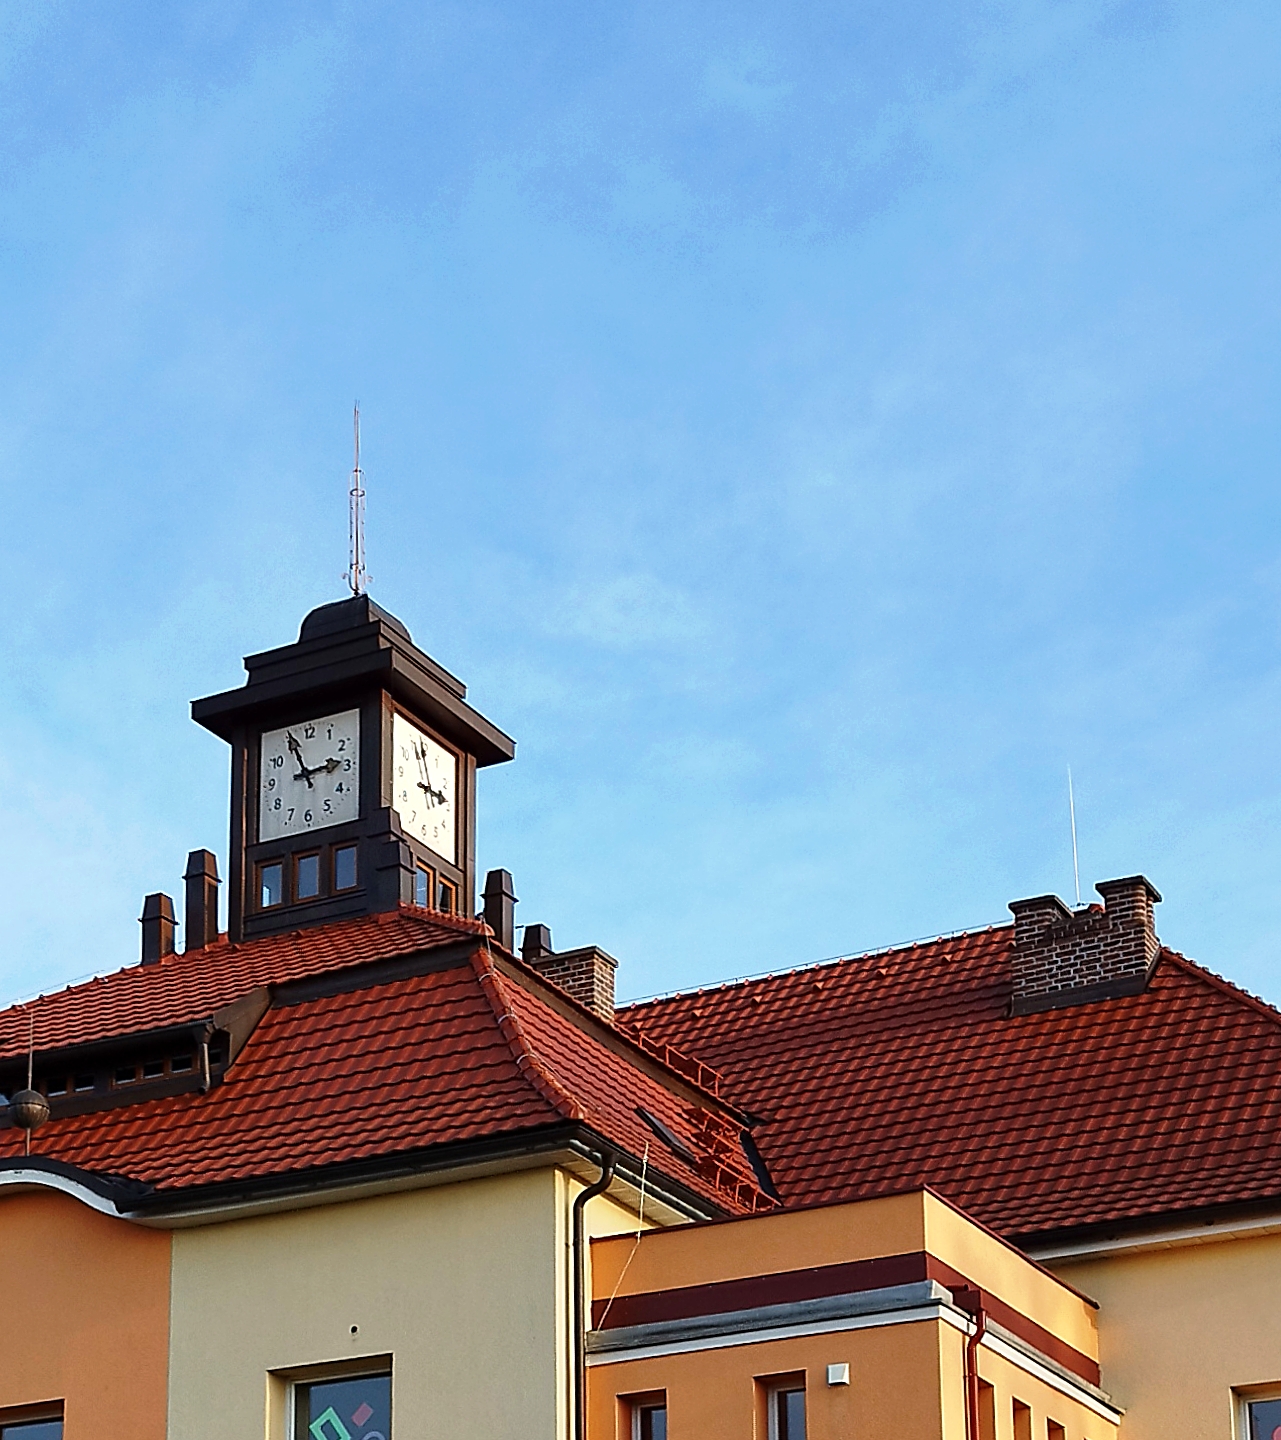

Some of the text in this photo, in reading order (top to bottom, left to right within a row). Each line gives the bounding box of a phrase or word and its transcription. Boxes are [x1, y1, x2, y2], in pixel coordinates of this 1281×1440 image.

[304, 727, 315, 739] 12
[327, 728, 332, 740] 1
[338, 739, 346, 752] 2
[269, 755, 284, 769] 10
[343, 759, 351, 771] 3
[268, 778, 276, 791] 9
[335, 782, 344, 793] 4
[274, 798, 282, 810] 8
[323, 799, 331, 812] 5
[287, 808, 295, 821] 7
[304, 809, 312, 822] 6
